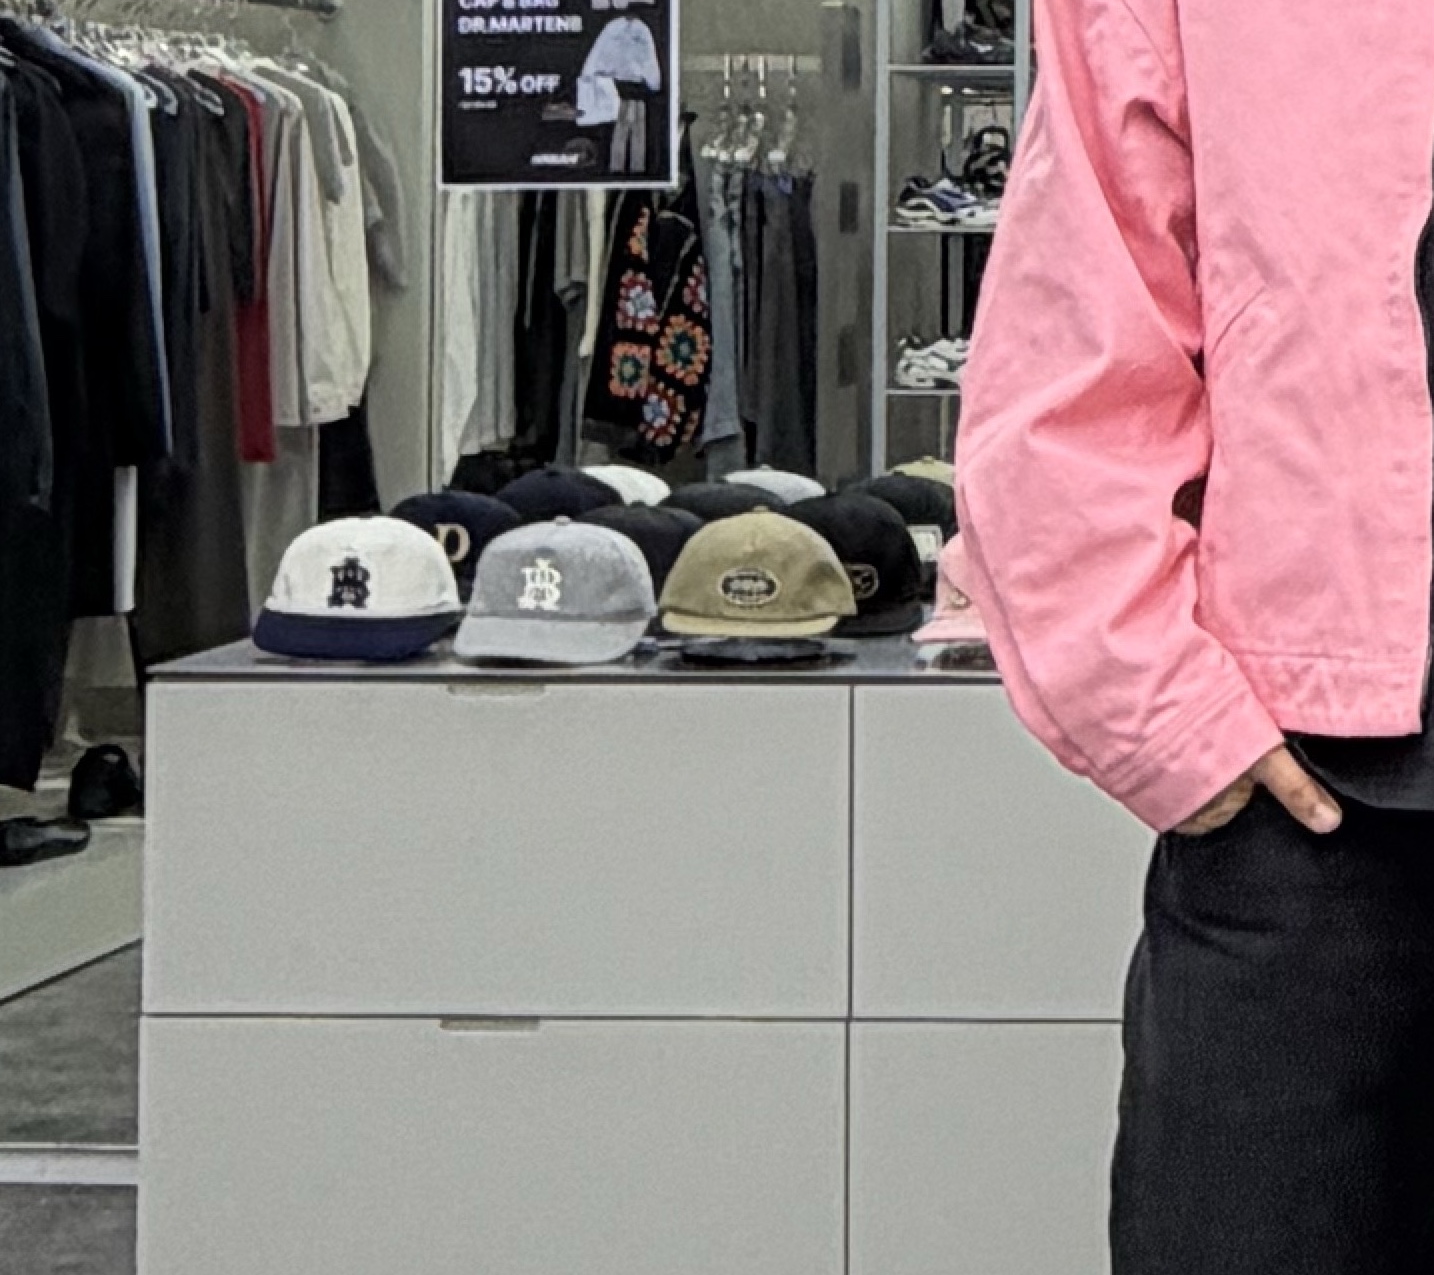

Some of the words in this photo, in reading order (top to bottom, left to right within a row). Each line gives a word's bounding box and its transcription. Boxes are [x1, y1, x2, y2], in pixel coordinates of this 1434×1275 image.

[458, 15, 583, 34] DR.MARTENS
[458, 66, 517, 94] 15%
[520, 74, 561, 94] OFF
